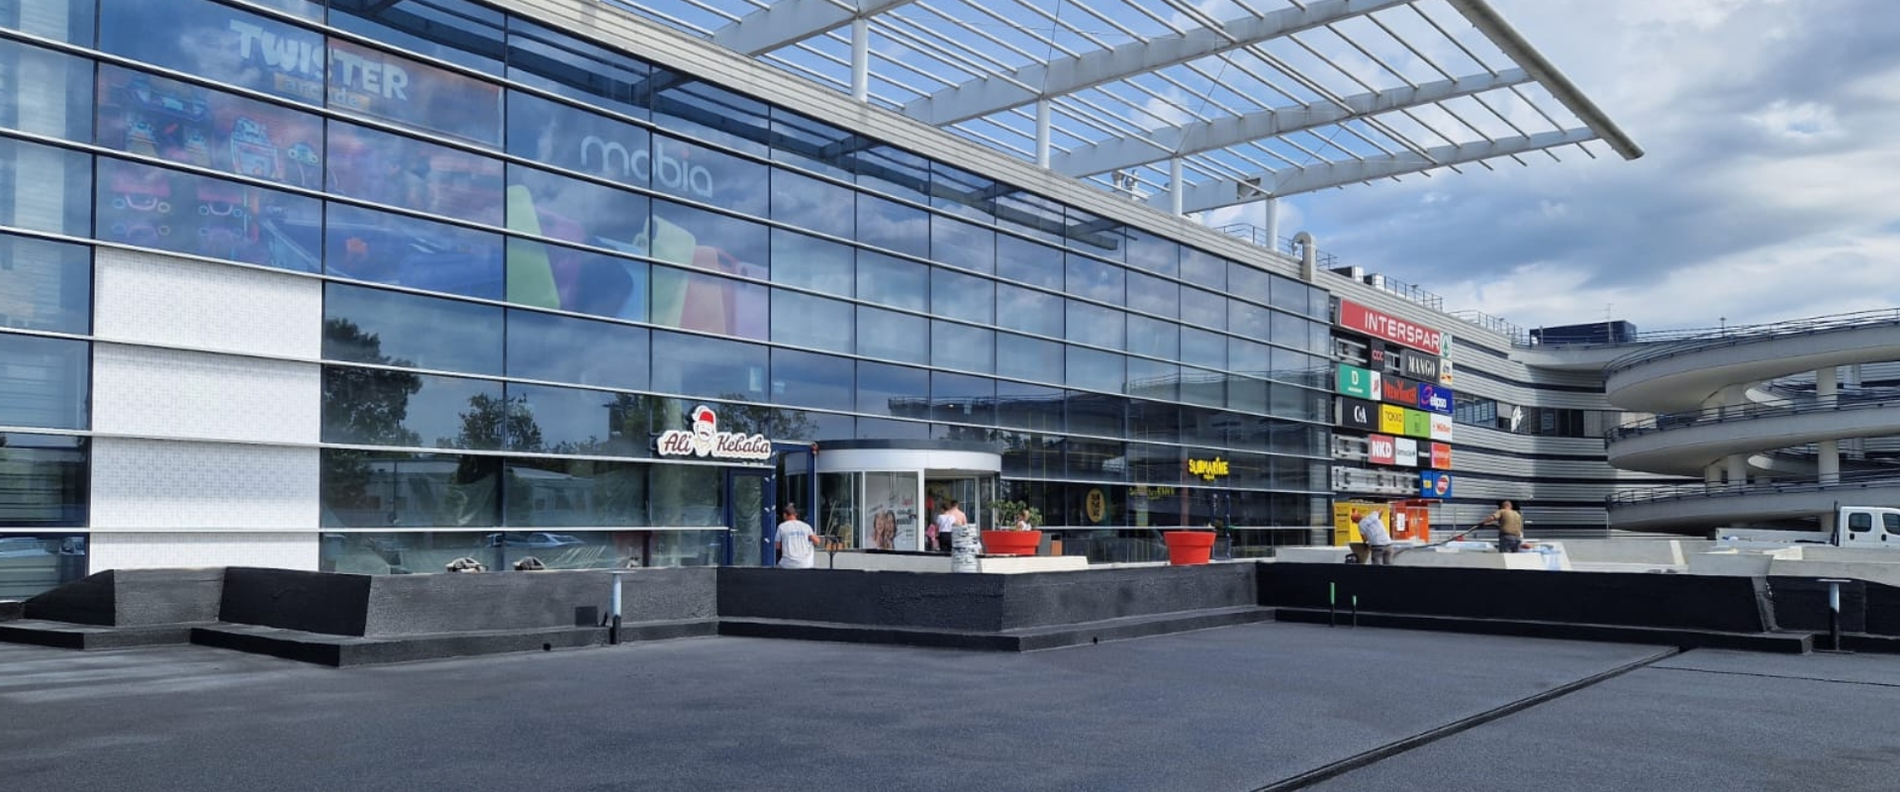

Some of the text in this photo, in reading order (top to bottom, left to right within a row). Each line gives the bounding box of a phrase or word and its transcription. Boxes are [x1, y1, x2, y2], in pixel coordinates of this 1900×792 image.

[230, 19, 408, 101] TWISTER
[580, 135, 713, 198] mobia
[1364, 311, 1440, 350] INTERSPAR
[1371, 350, 1384, 361] CCC
[1408, 355, 1436, 378] MANGO
[664, 432, 769, 454] Ali Kebaba
[1372, 440, 1392, 458] NKD
